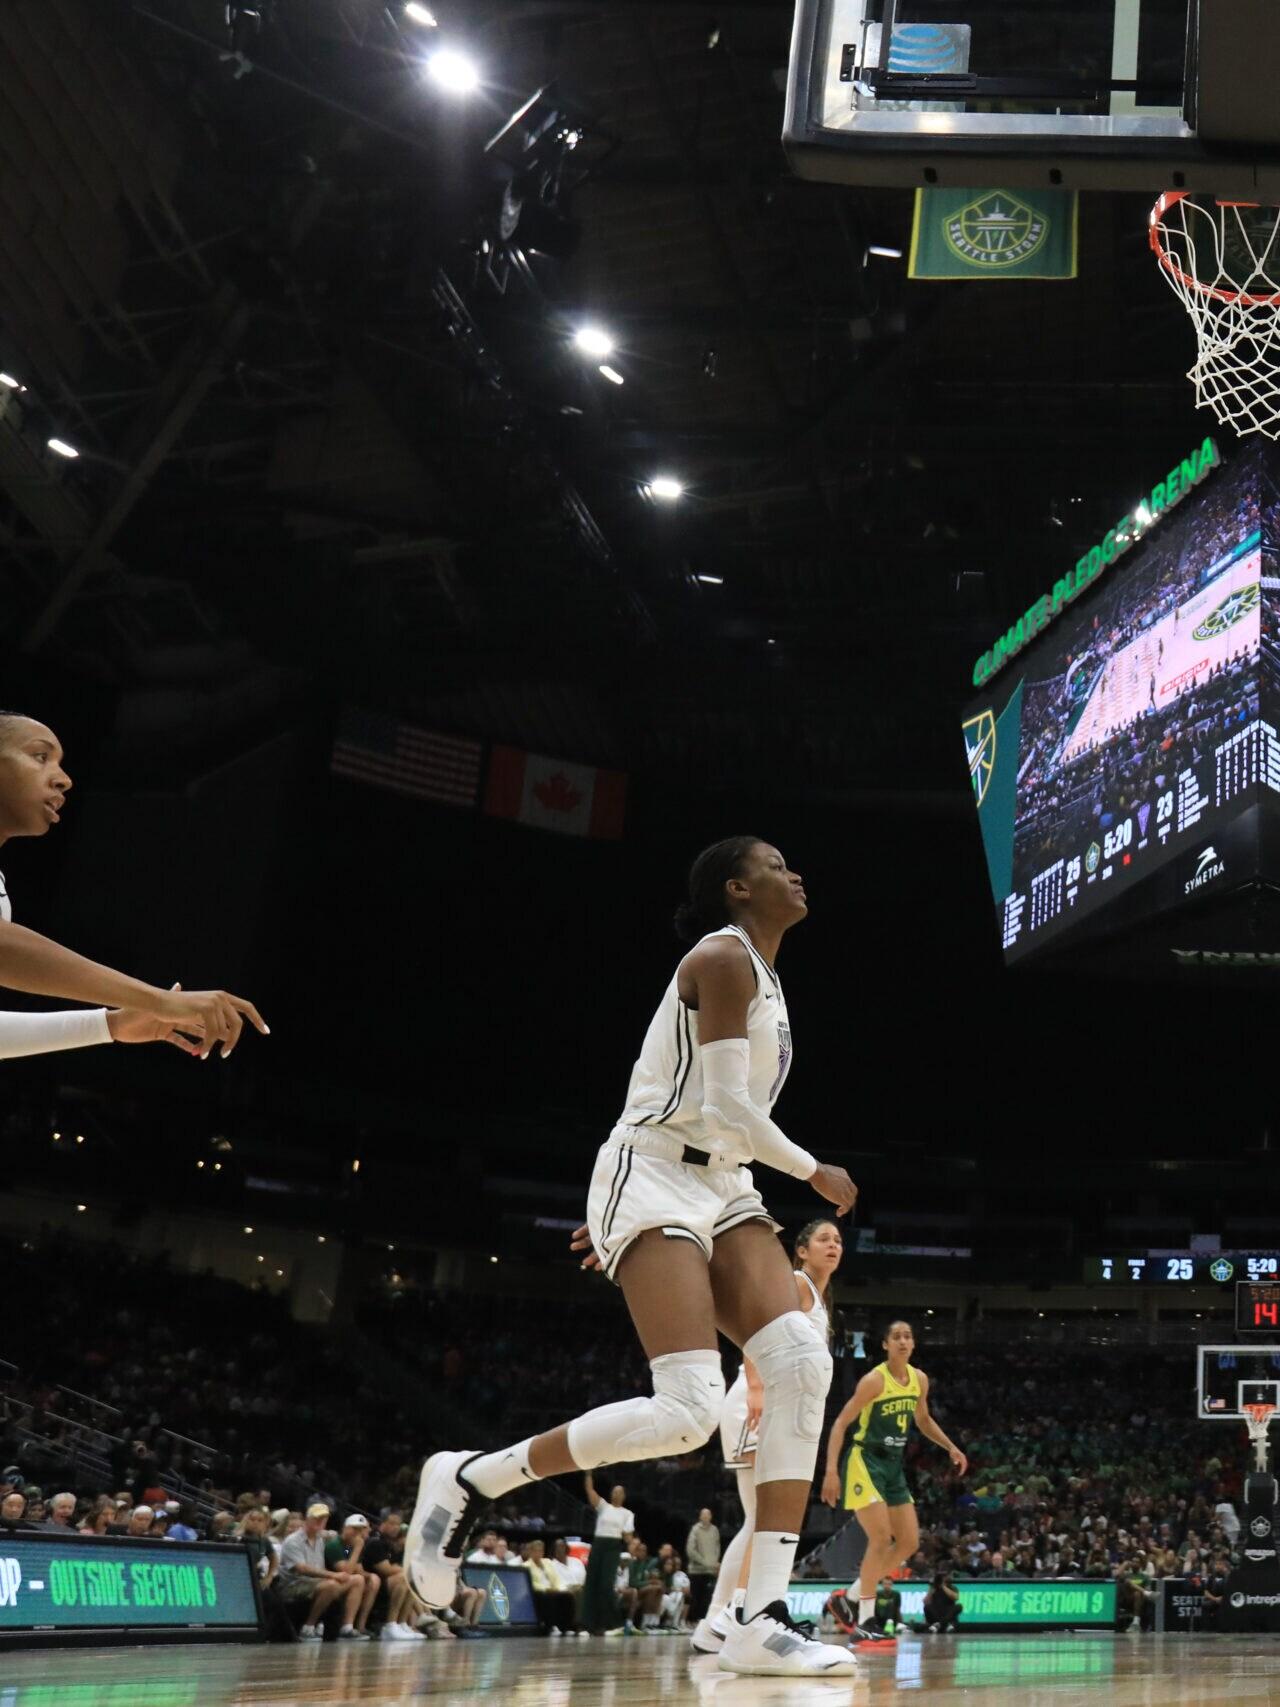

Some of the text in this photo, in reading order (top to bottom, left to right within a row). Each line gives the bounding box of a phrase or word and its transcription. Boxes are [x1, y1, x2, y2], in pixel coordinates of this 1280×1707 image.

[950, 223, 1042, 262] SEATTLE STORM
[971, 594, 1054, 688] CLIMATE
[1156, 790, 1173, 823] 23
[1103, 818, 1132, 859] 5:20
[1066, 855, 1081, 886] 25
[1184, 861, 1225, 895] SYMETRA
[1131, 1267, 1141, 1280] 2
[1167, 1259, 1193, 1280] 25
[1247, 1258, 1277, 1273] 5:20
[1254, 1303, 1278, 1325] 14
[896, 1414, 907, 1434] 4
[50, 1560, 130, 1607] OUTSIDE
[130, 1562, 203, 1607] SECTION
[204, 1566, 217, 1607] 9
[1022, 1591, 1087, 1614] SECTION
[1092, 1591, 1104, 1614] 9
